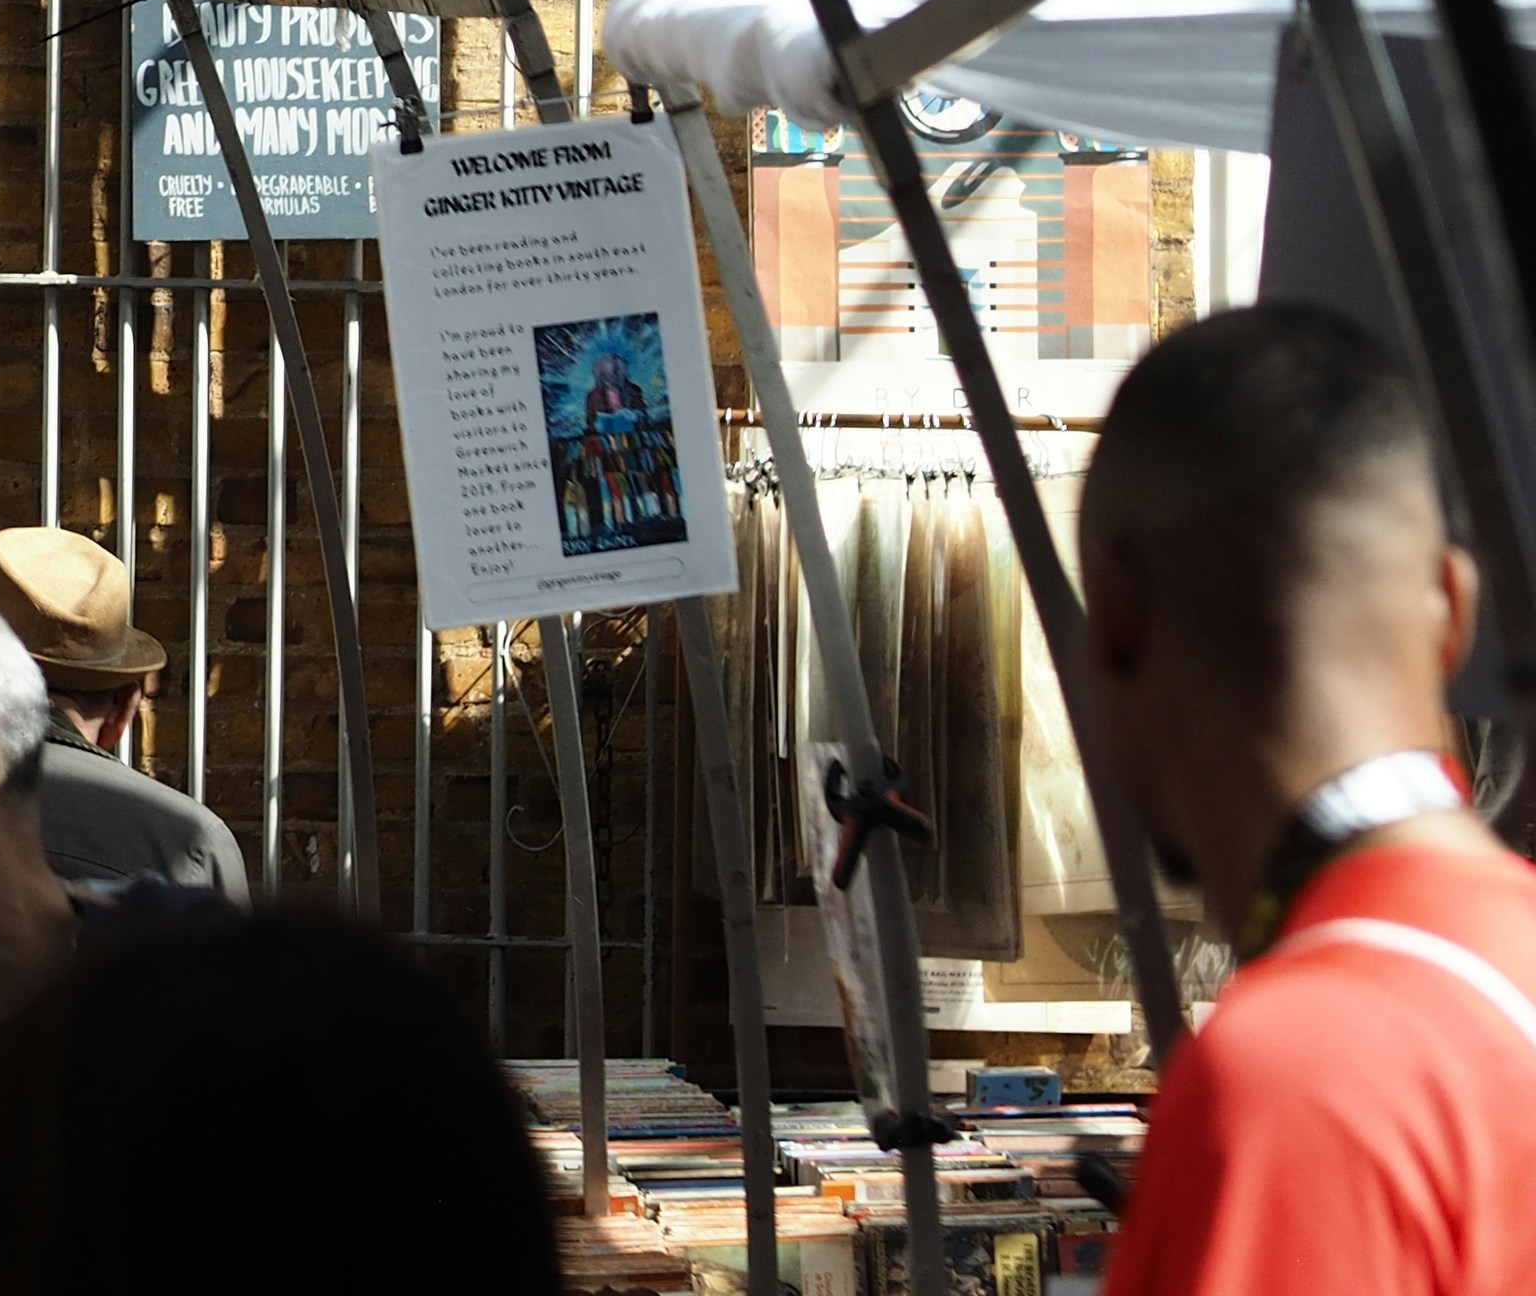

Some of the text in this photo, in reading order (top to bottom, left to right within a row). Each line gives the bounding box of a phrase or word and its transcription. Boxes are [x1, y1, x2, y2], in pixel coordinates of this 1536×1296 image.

[162, 1, 273, 48] BAUTY
[232, 55, 440, 105] HOUSEKEEPNG
[234, 105, 319, 157] MANY
[325, 106, 398, 156] MOR
[450, 140, 613, 179] WELCOME FROM
[158, 174, 213, 197] CRUELTY
[423, 172, 645, 218] GINGER KITTY VINTAGE
[168, 197, 205, 218] FREE
[458, 242, 492, 256] been
[494, 235, 549, 252] reading
[552, 229, 578, 245] and
[432, 241, 647, 280] collecting books in south east
[433, 281, 484, 299] London
[485, 278, 509, 295] for
[512, 275, 544, 289] over
[547, 270, 591, 286] thirty
[464, 322, 506, 344] proud
[508, 322, 525, 336] to
[442, 345, 513, 363] have been
[446, 364, 520, 382] sharing my
[446, 382, 495, 402] love of
[449, 398, 528, 422] books with
[453, 421, 528, 440] visitors to
[454, 439, 529, 460] Greenwich
[457, 457, 548, 479] Market since
[499, 479, 537, 493] From
[463, 498, 526, 518] one book
[464, 519, 522, 538] lover to
[470, 558, 514, 577] Enjoy!
